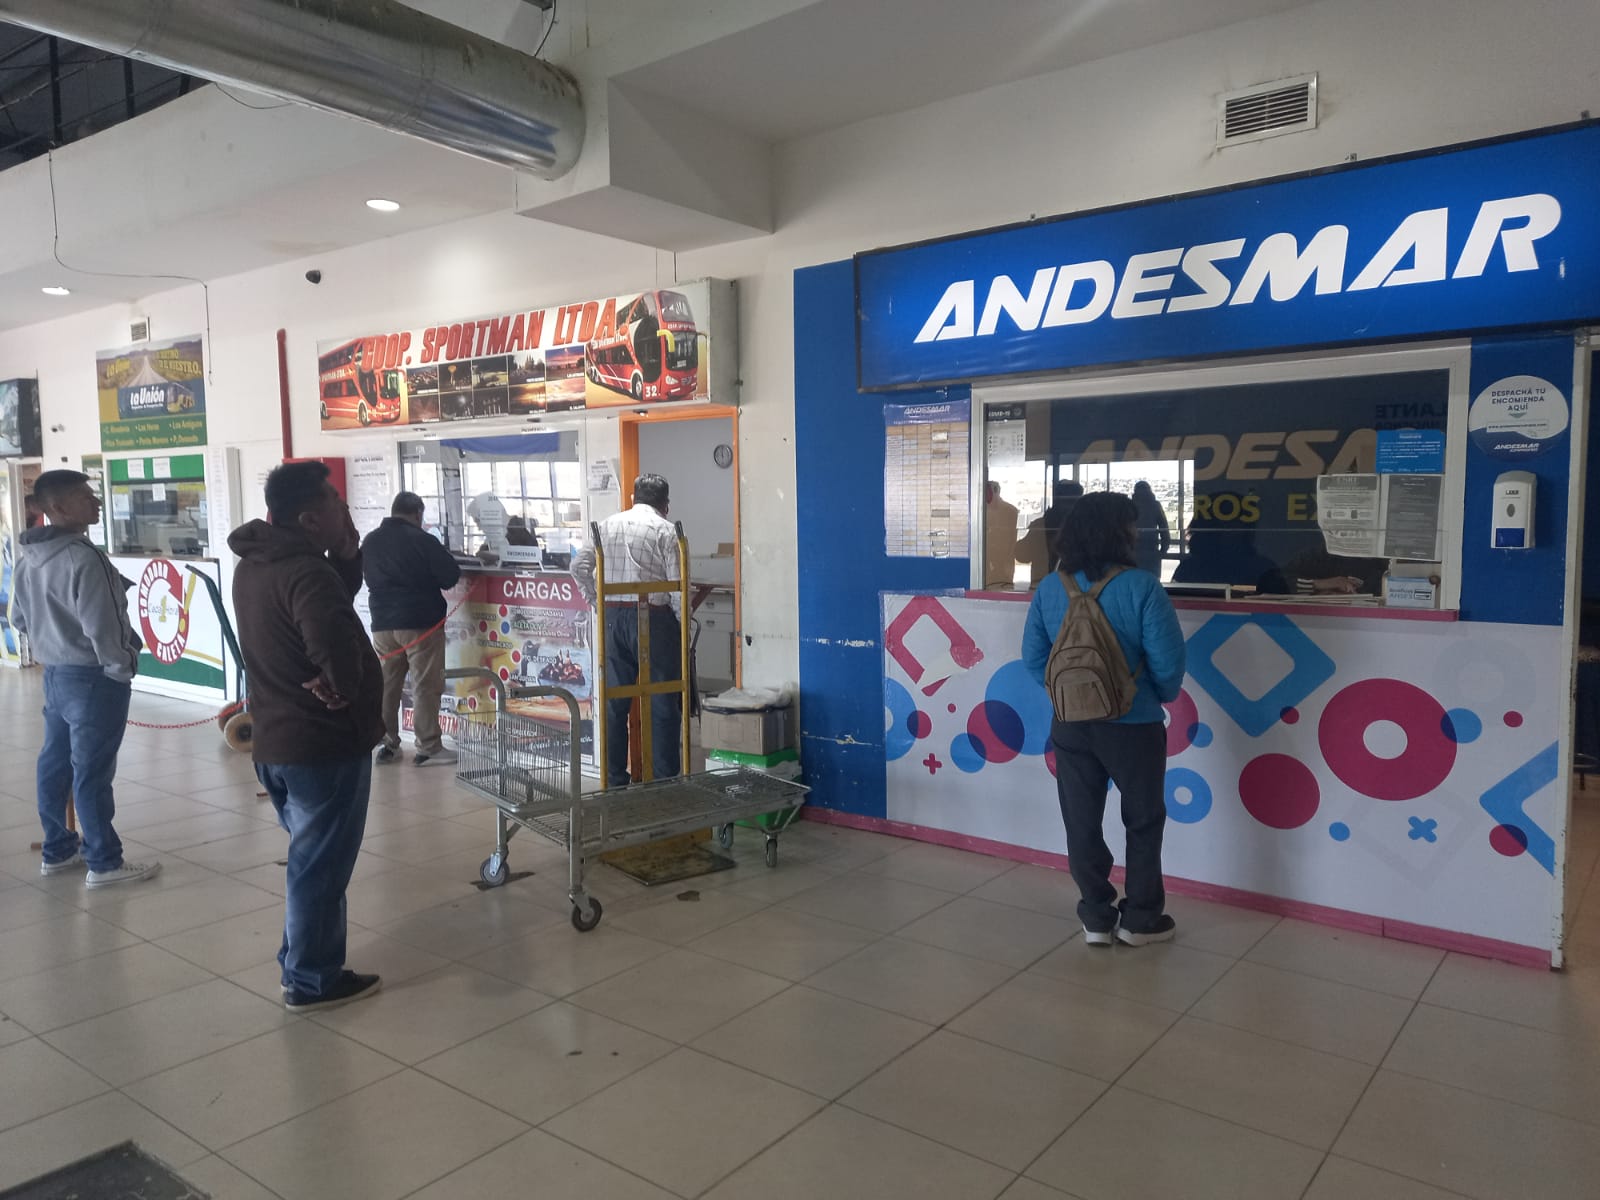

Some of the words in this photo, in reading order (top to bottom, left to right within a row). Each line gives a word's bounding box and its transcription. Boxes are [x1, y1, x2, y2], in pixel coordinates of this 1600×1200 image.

[913, 193, 1562, 345] ANDESMAR
[361, 331, 412, 373] COOP.
[420, 309, 546, 364] SPORTMAN
[553, 297, 629, 347] LTDA.
[903, 404, 951, 415] ANDESMAR
[1491, 396, 1545, 405] ENCOMIENDA
[1507, 402, 1529, 411] AQUÍ
[1493, 442, 1540, 450] ANDESMAR
[140, 561, 169, 618] COMODORO
[503, 580, 572, 601] CARGAS
[156, 632, 186, 663] CALETA
